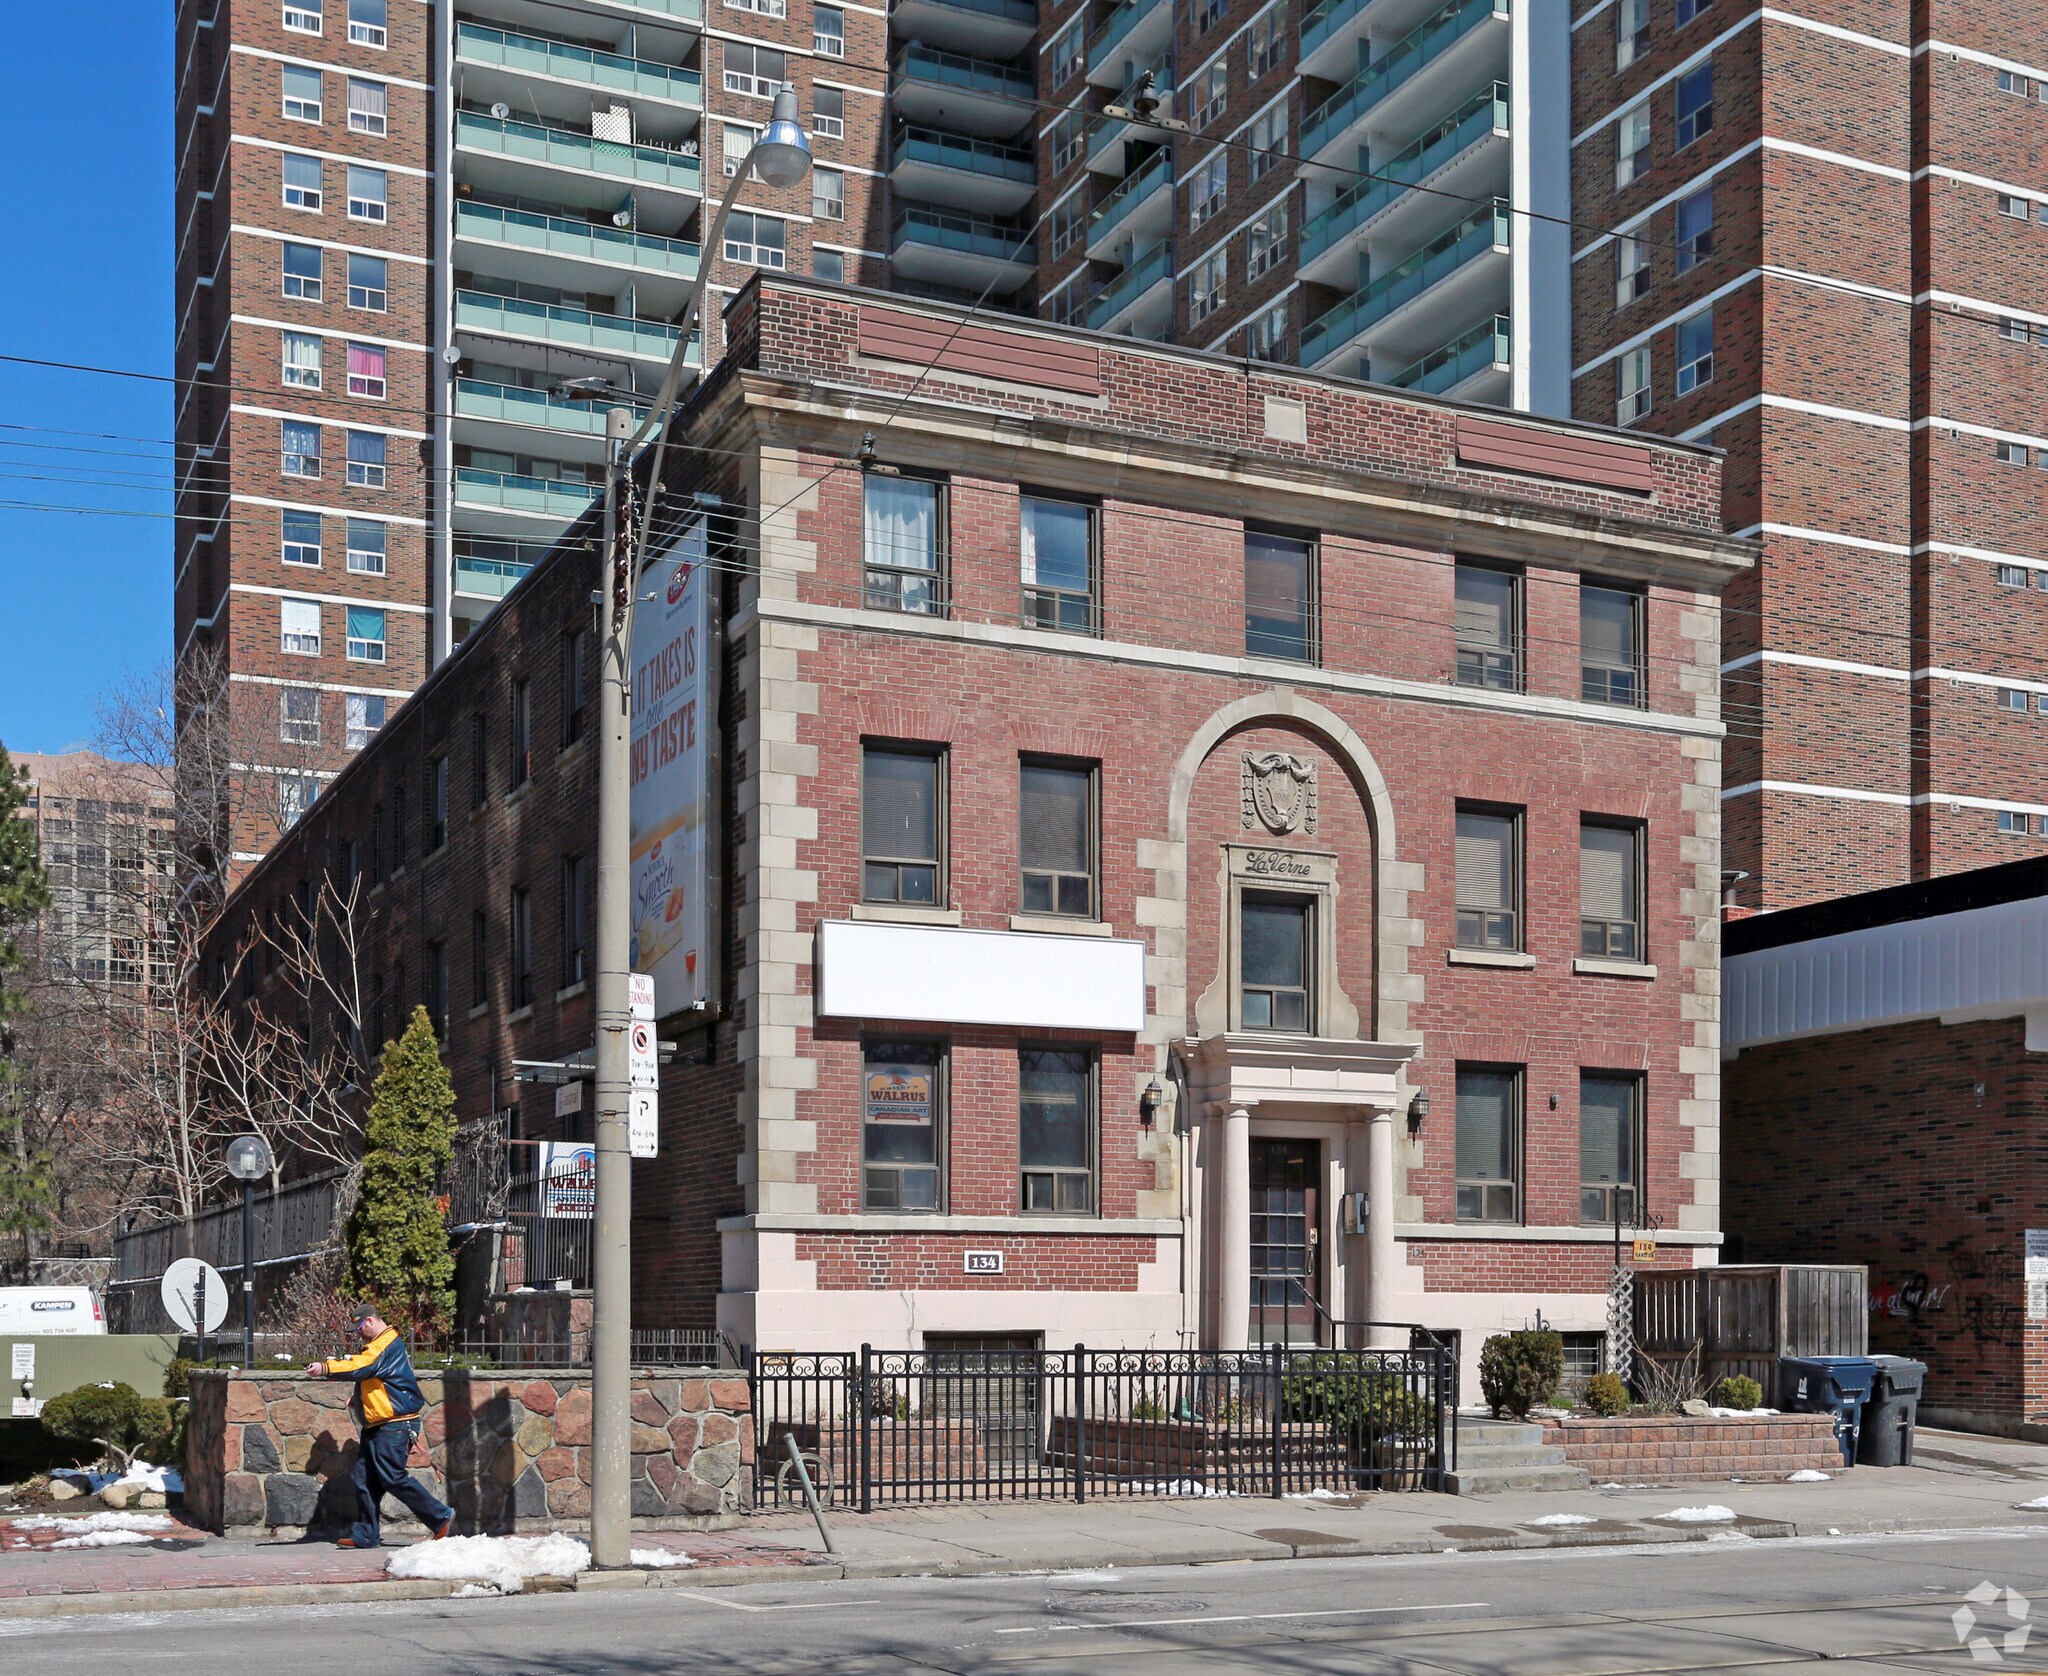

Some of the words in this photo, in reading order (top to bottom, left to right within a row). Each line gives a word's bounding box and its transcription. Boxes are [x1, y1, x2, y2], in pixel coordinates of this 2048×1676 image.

[637, 662, 647, 715] IT
[649, 636, 682, 705] TAKES
[684, 625, 696, 679] IS
[645, 699, 664, 731] one
[630, 732, 649, 789] NY
[651, 698, 697, 775] TASTE
[632, 856, 674, 933] Smooth
[635, 977, 646, 991] NO
[629, 991, 653, 1006] STANDING
[870, 1090, 926, 1102] WALRUS
[971, 1256, 997, 1269] 134
[33, 1301, 73, 1310] KAMPEN
